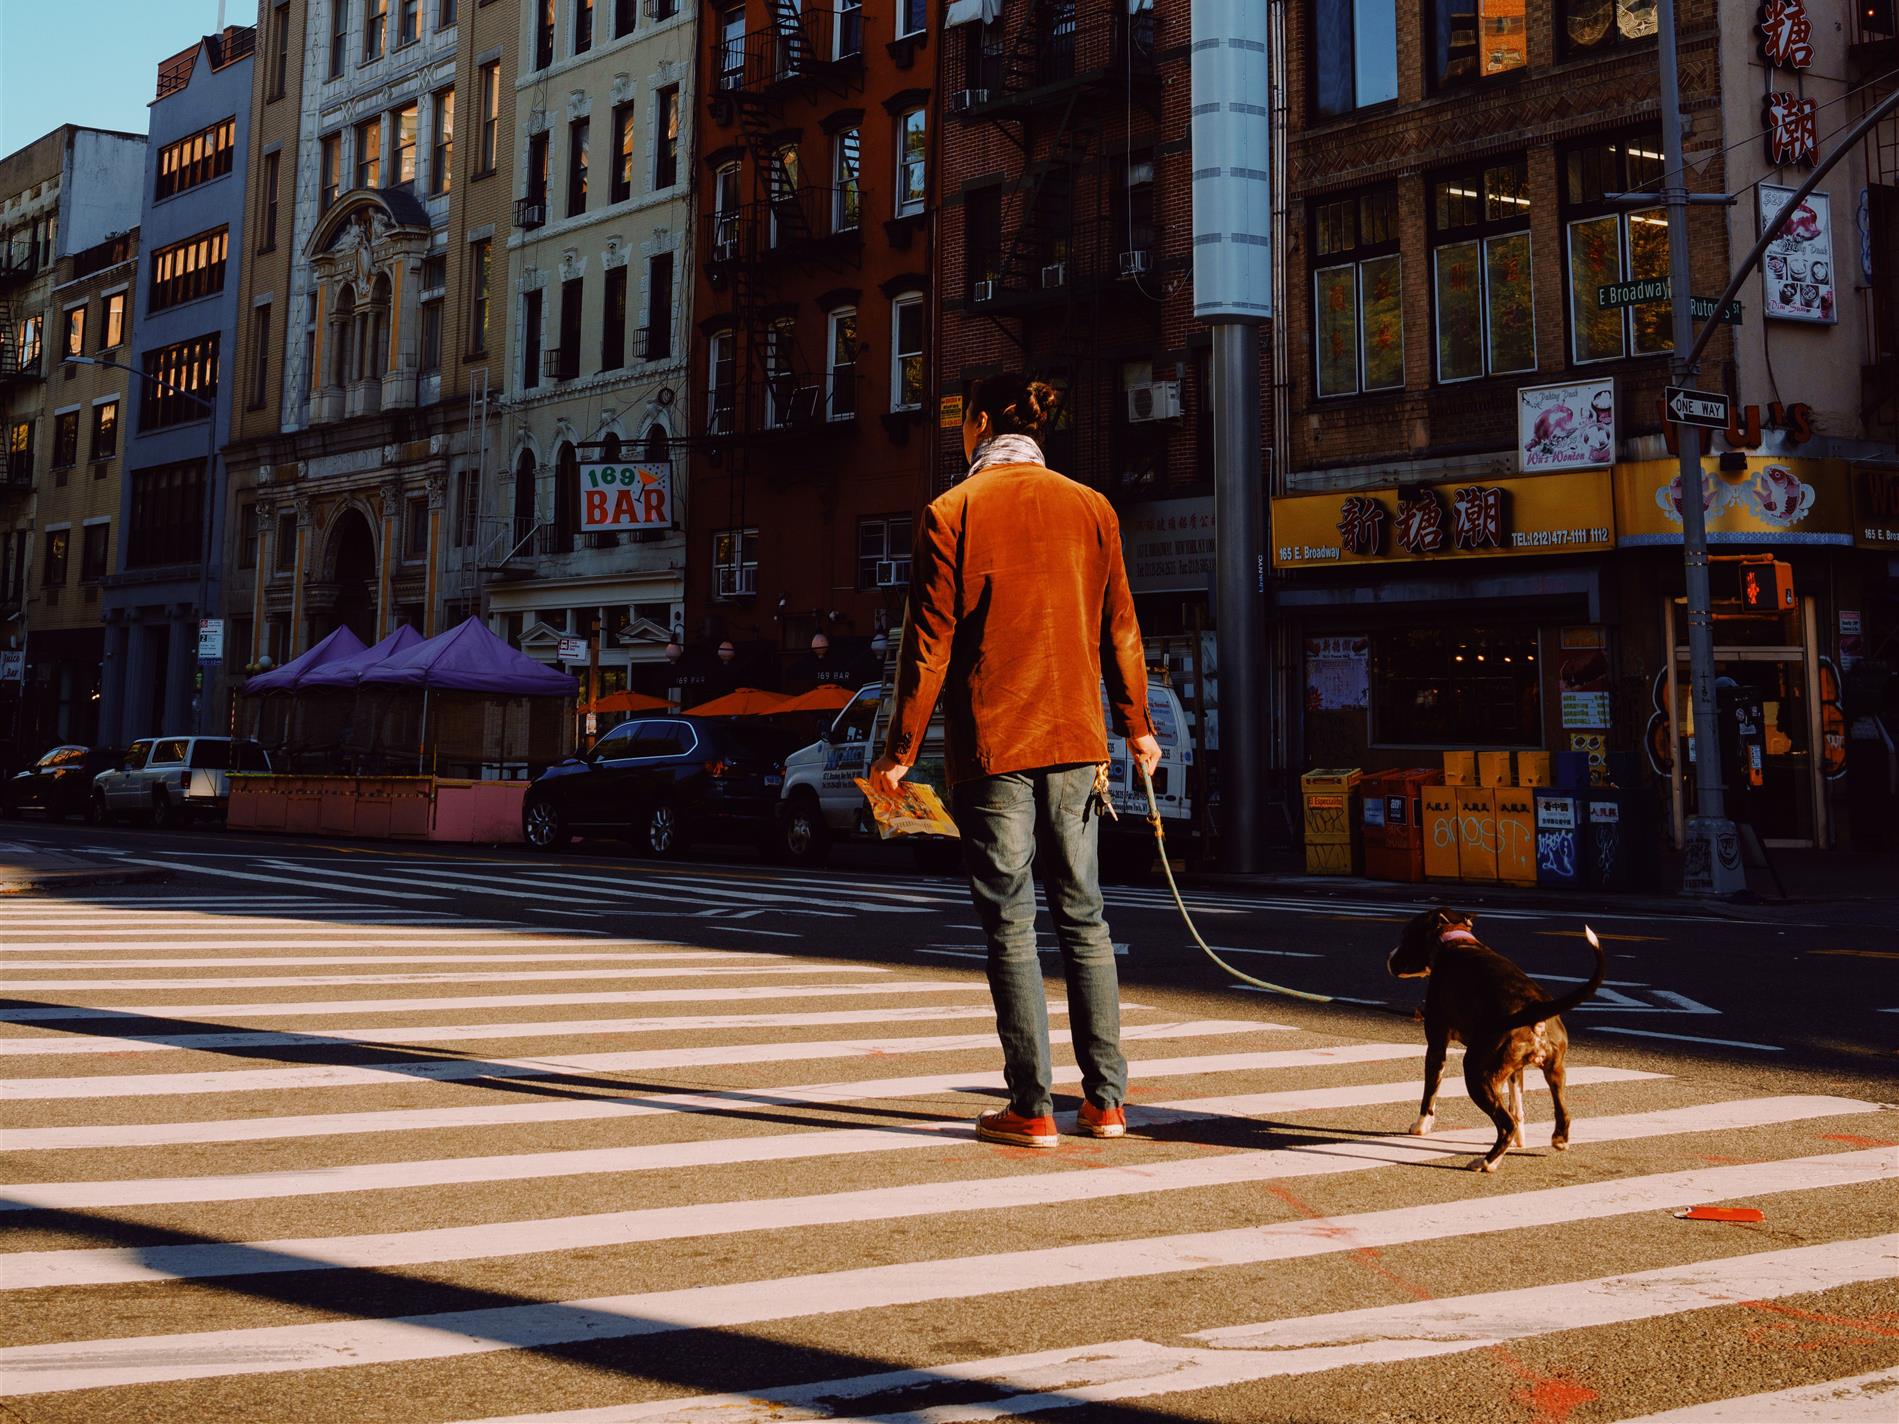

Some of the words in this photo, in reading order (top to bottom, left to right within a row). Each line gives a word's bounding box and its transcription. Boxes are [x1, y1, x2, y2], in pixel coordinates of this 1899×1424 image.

[1599, 288, 1606, 305] E
[1610, 281, 1668, 304] Broadway
[1690, 298, 1730, 319] Rutgs
[1676, 398, 1694, 414] ONE
[1701, 402, 1721, 417] WAY
[588, 465, 636, 488] 169
[584, 488, 668, 525] BAR
[1337, 486, 1504, 555] 新糖潮
[1864, 528, 1876, 540] 165
[1279, 546, 1293, 561] 165
[1294, 545, 1302, 560] E.
[1303, 544, 1340, 560] Broadway
